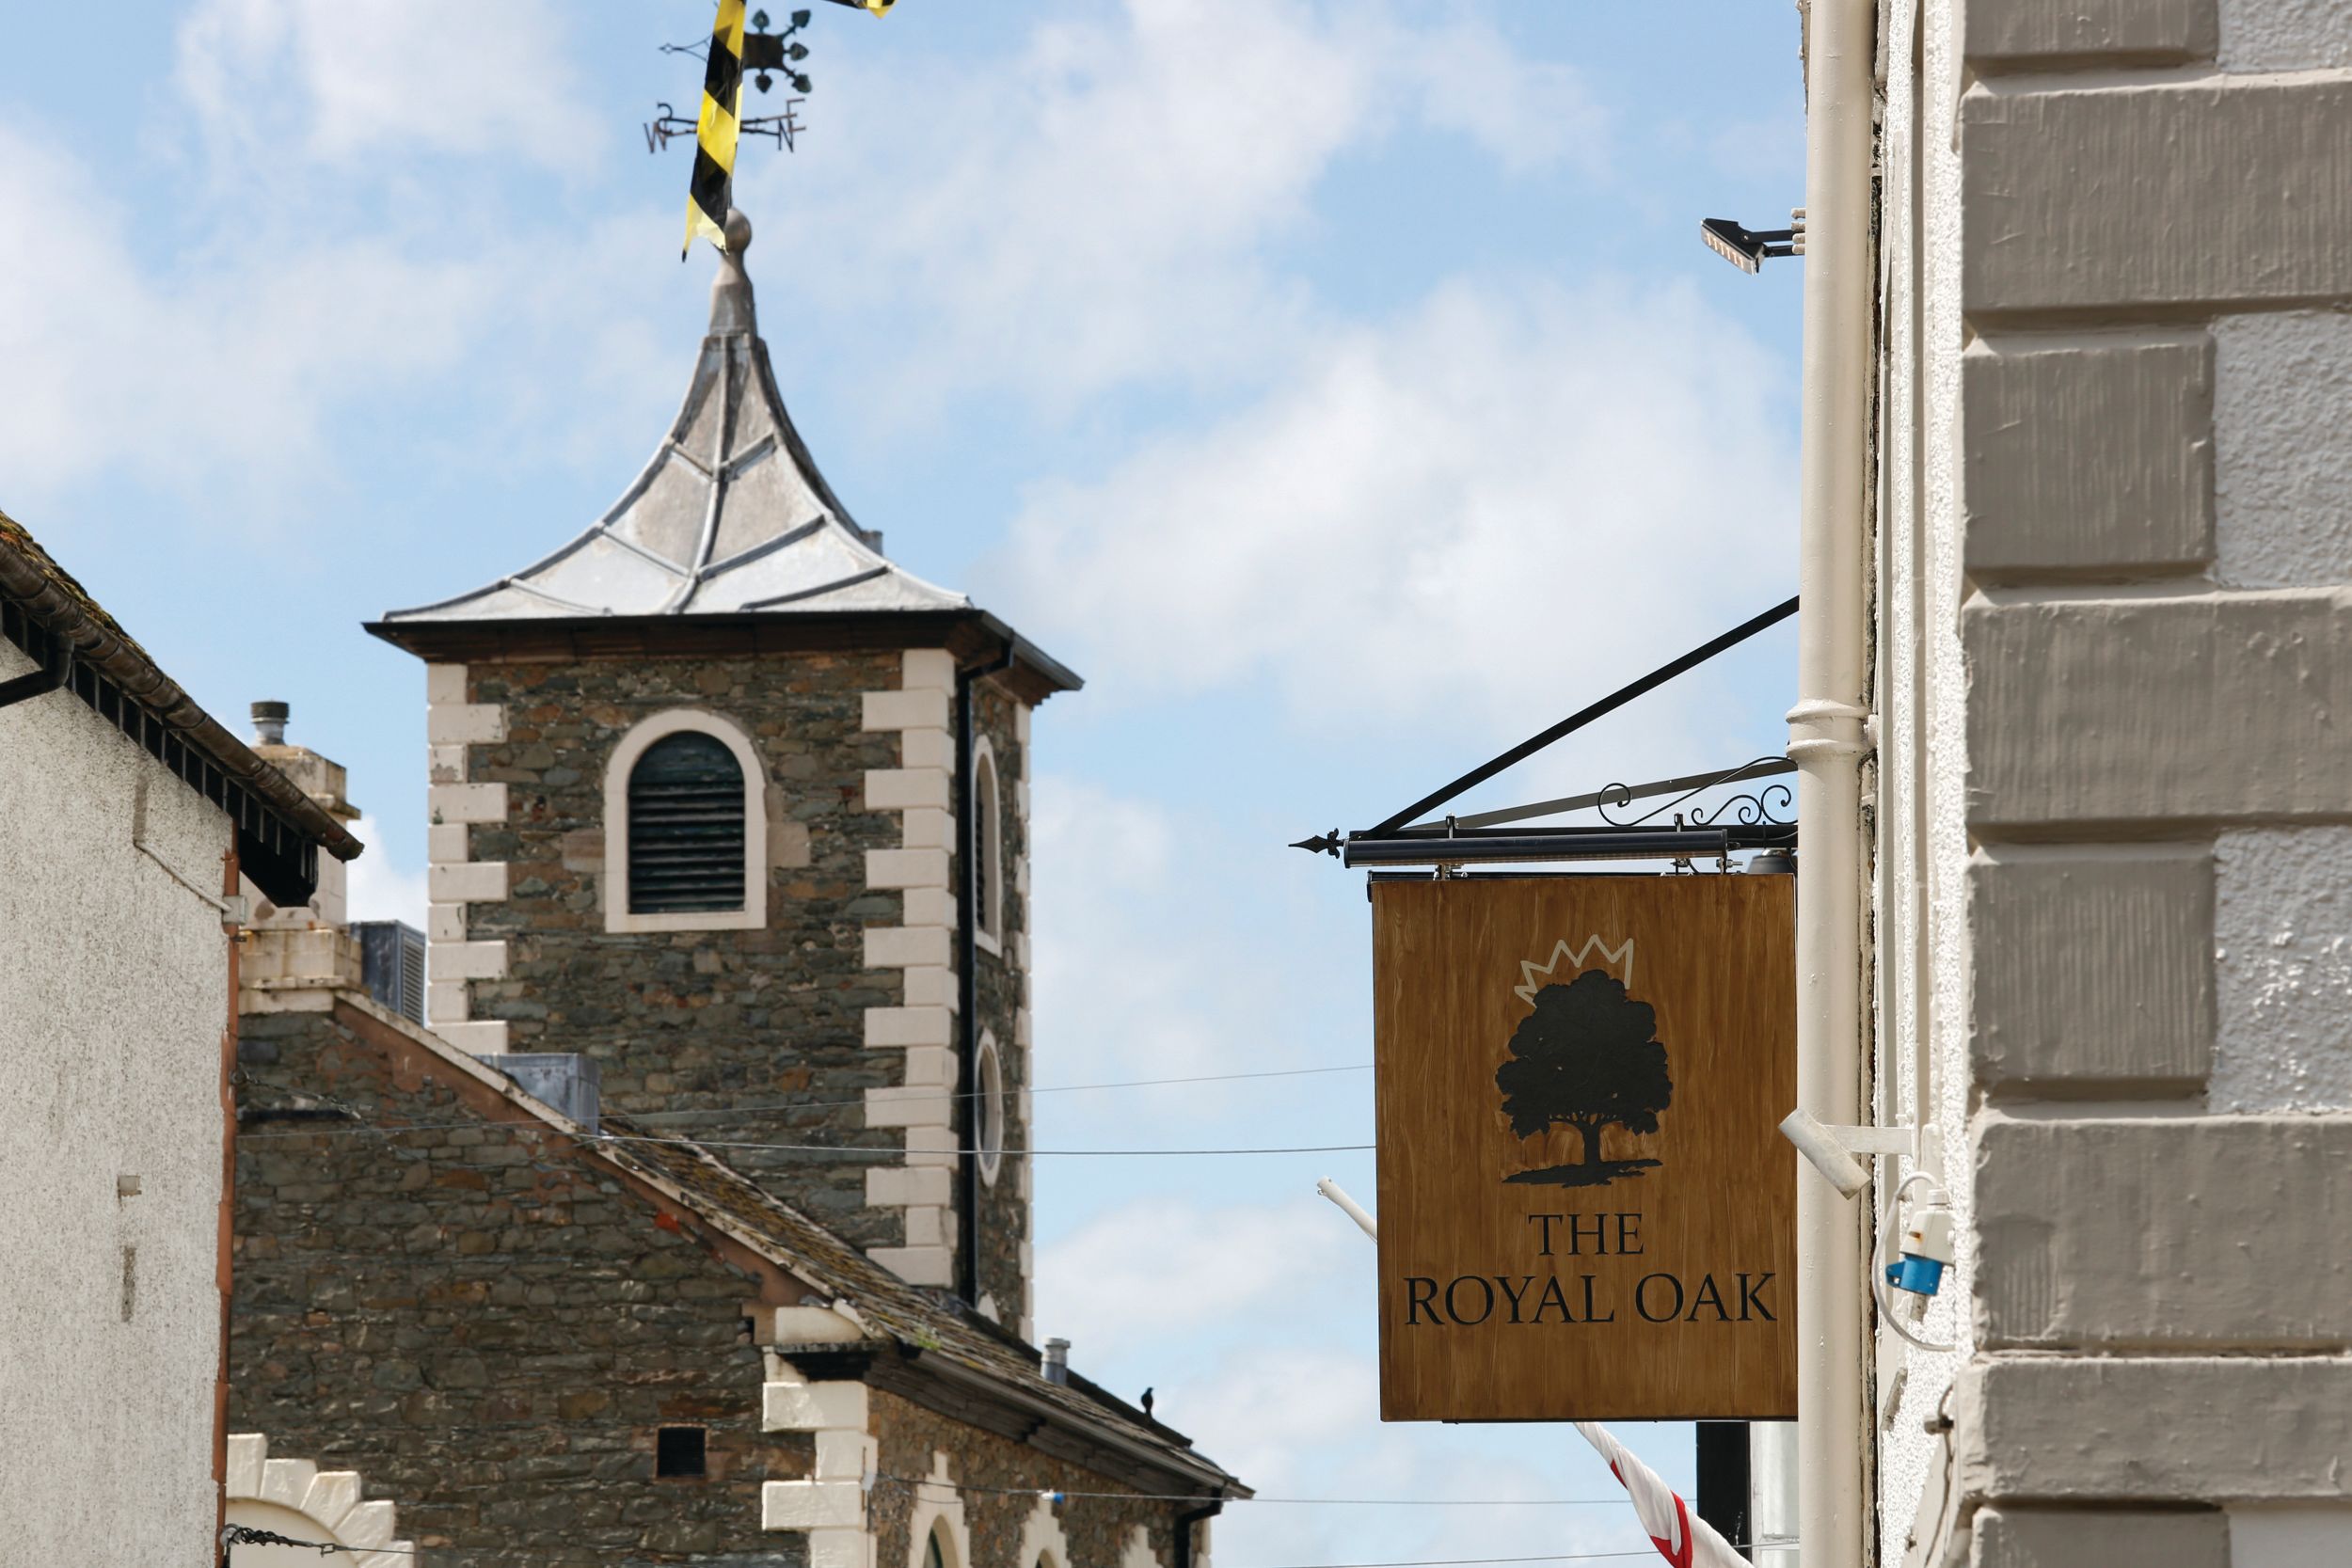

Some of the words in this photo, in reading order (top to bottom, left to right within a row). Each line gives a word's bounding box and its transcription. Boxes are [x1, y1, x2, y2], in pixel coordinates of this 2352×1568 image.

[1528, 1212, 1645, 1256] THE
[1403, 1275, 1615, 1325] ROYAL
[1635, 1273, 1778, 1323] OAK
